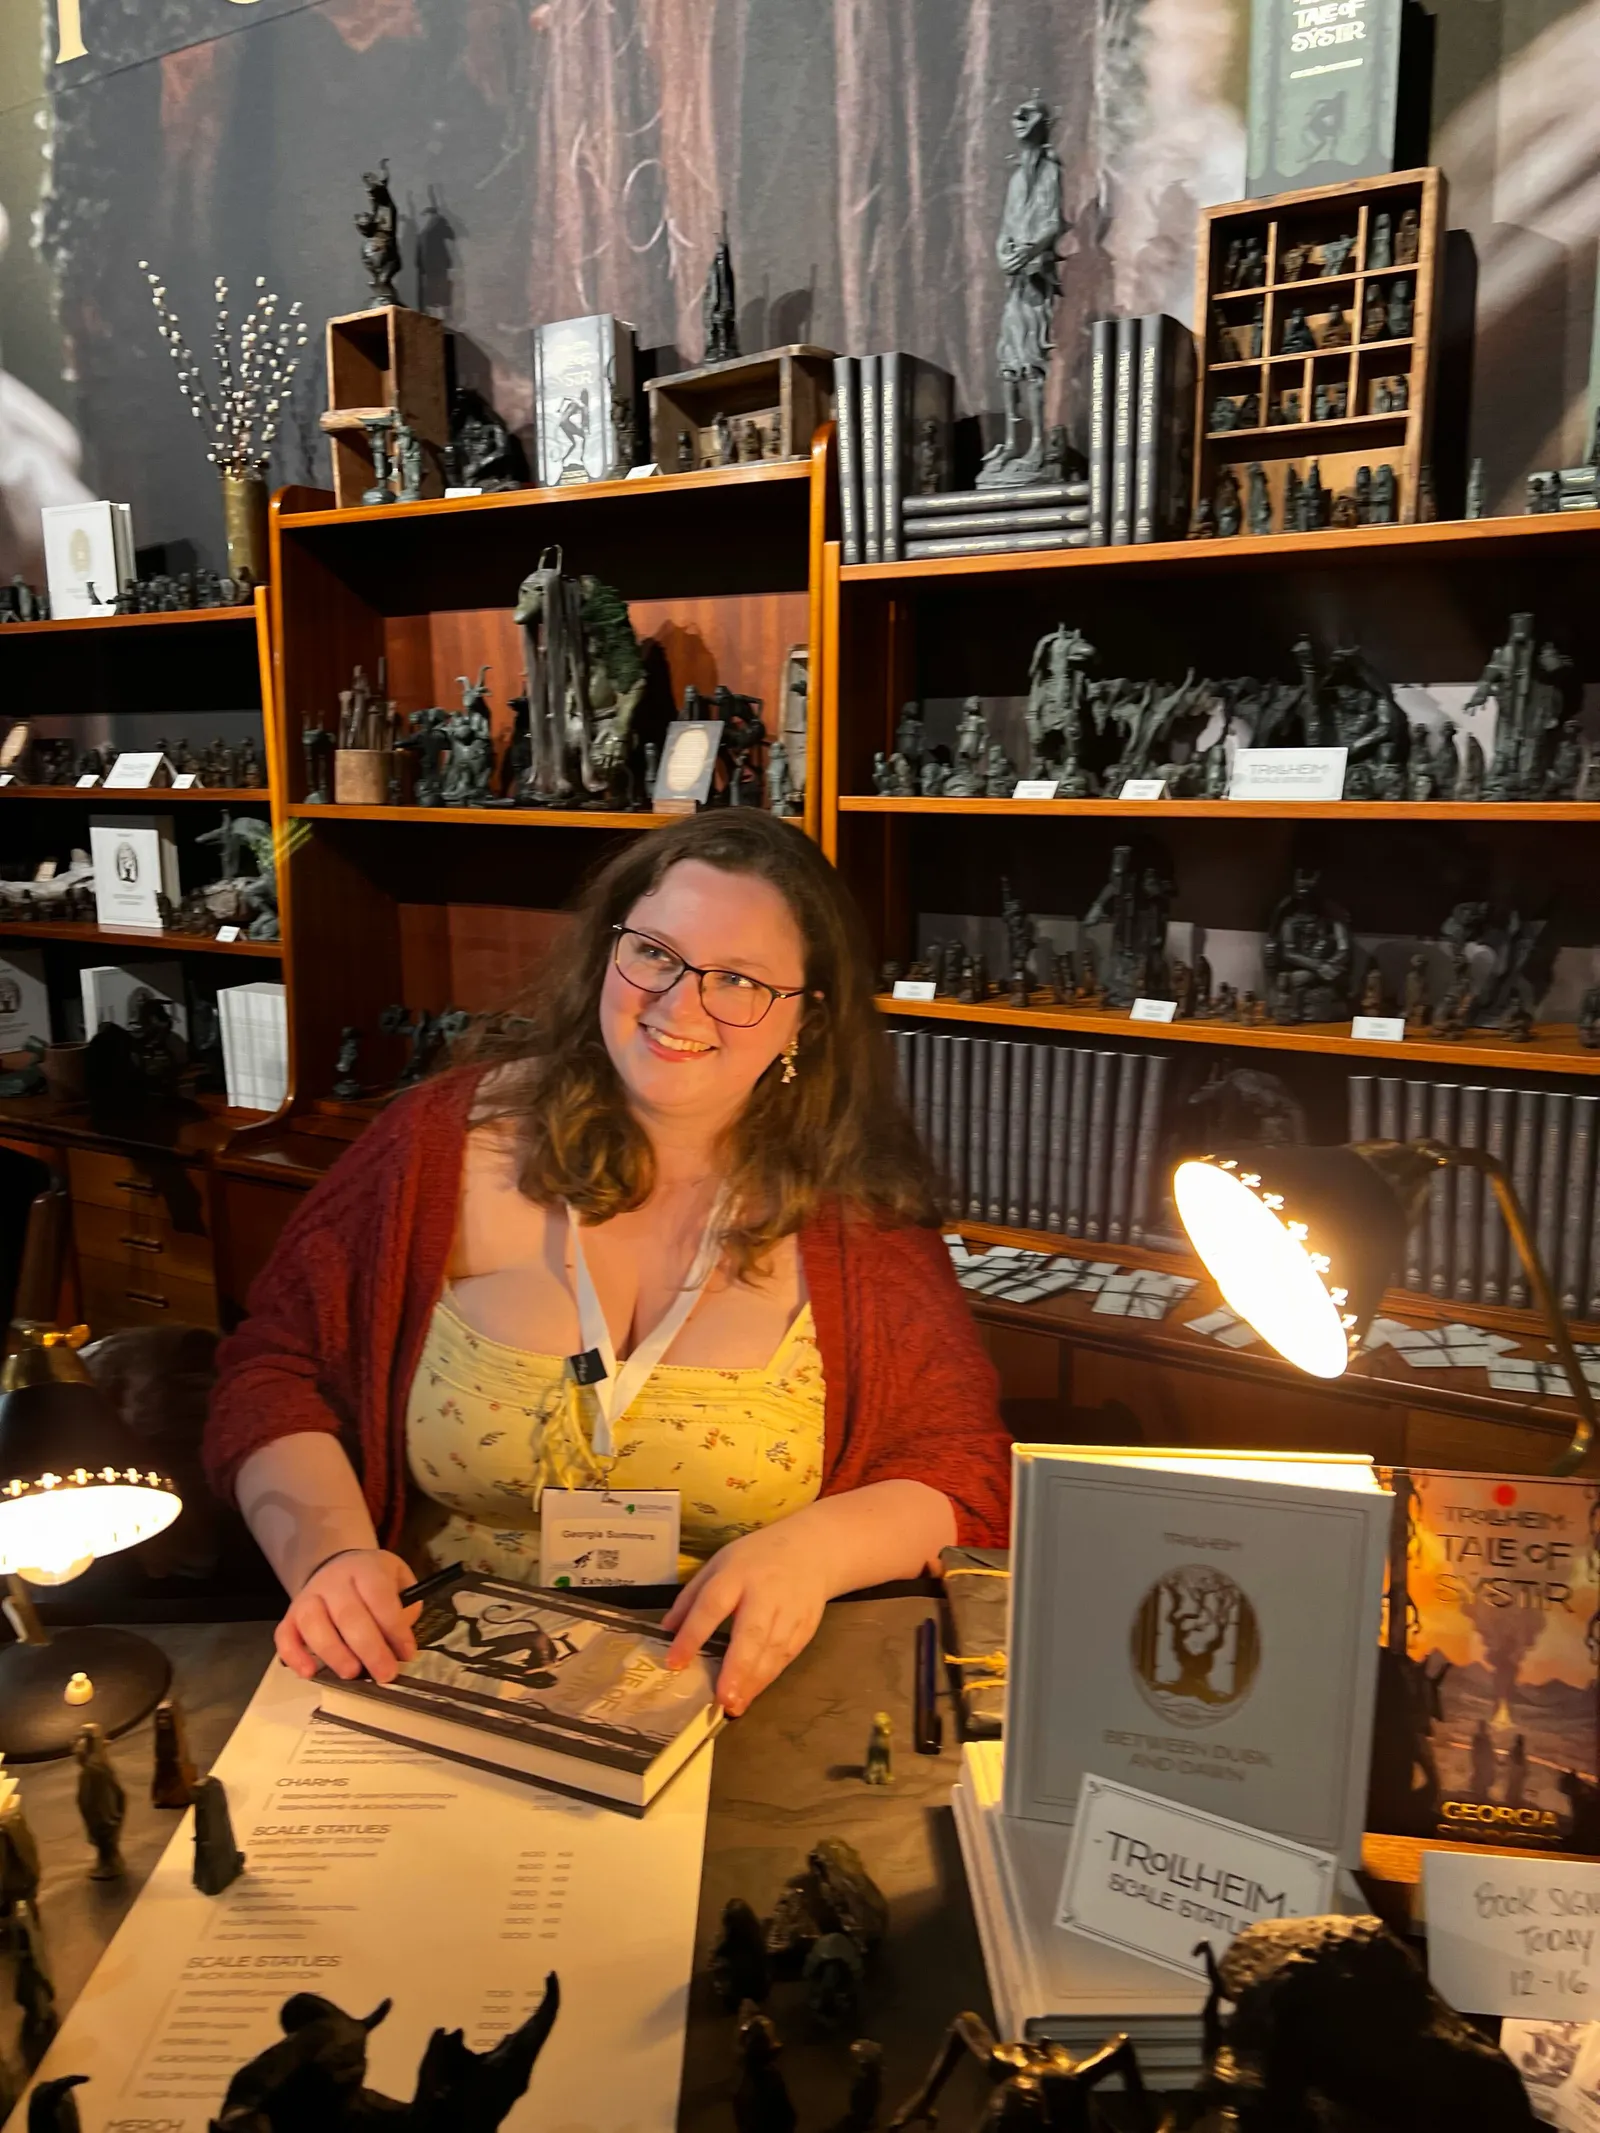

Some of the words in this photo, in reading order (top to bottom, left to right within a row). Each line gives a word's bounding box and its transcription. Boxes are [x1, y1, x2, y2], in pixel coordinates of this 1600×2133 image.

[562, 1530, 603, 1541] Georgia
[606, 1530, 656, 1541] Summers
[1437, 1533, 1518, 1567] TALE
[275, 1777, 350, 1788] CHARMS
[1441, 1800, 1558, 1827] GEORGIA
[252, 1824, 310, 1836] SCALE
[313, 1823, 392, 1835] STATUES
[1107, 1872, 1177, 1912] SCALE
[1177, 1898, 1254, 1936] STATU
[1515, 1925, 1596, 1967] TODAY
[186, 1956, 252, 1969] SCALE
[254, 1955, 343, 1968] STATUES
[102, 2119, 186, 2133] MERCH
